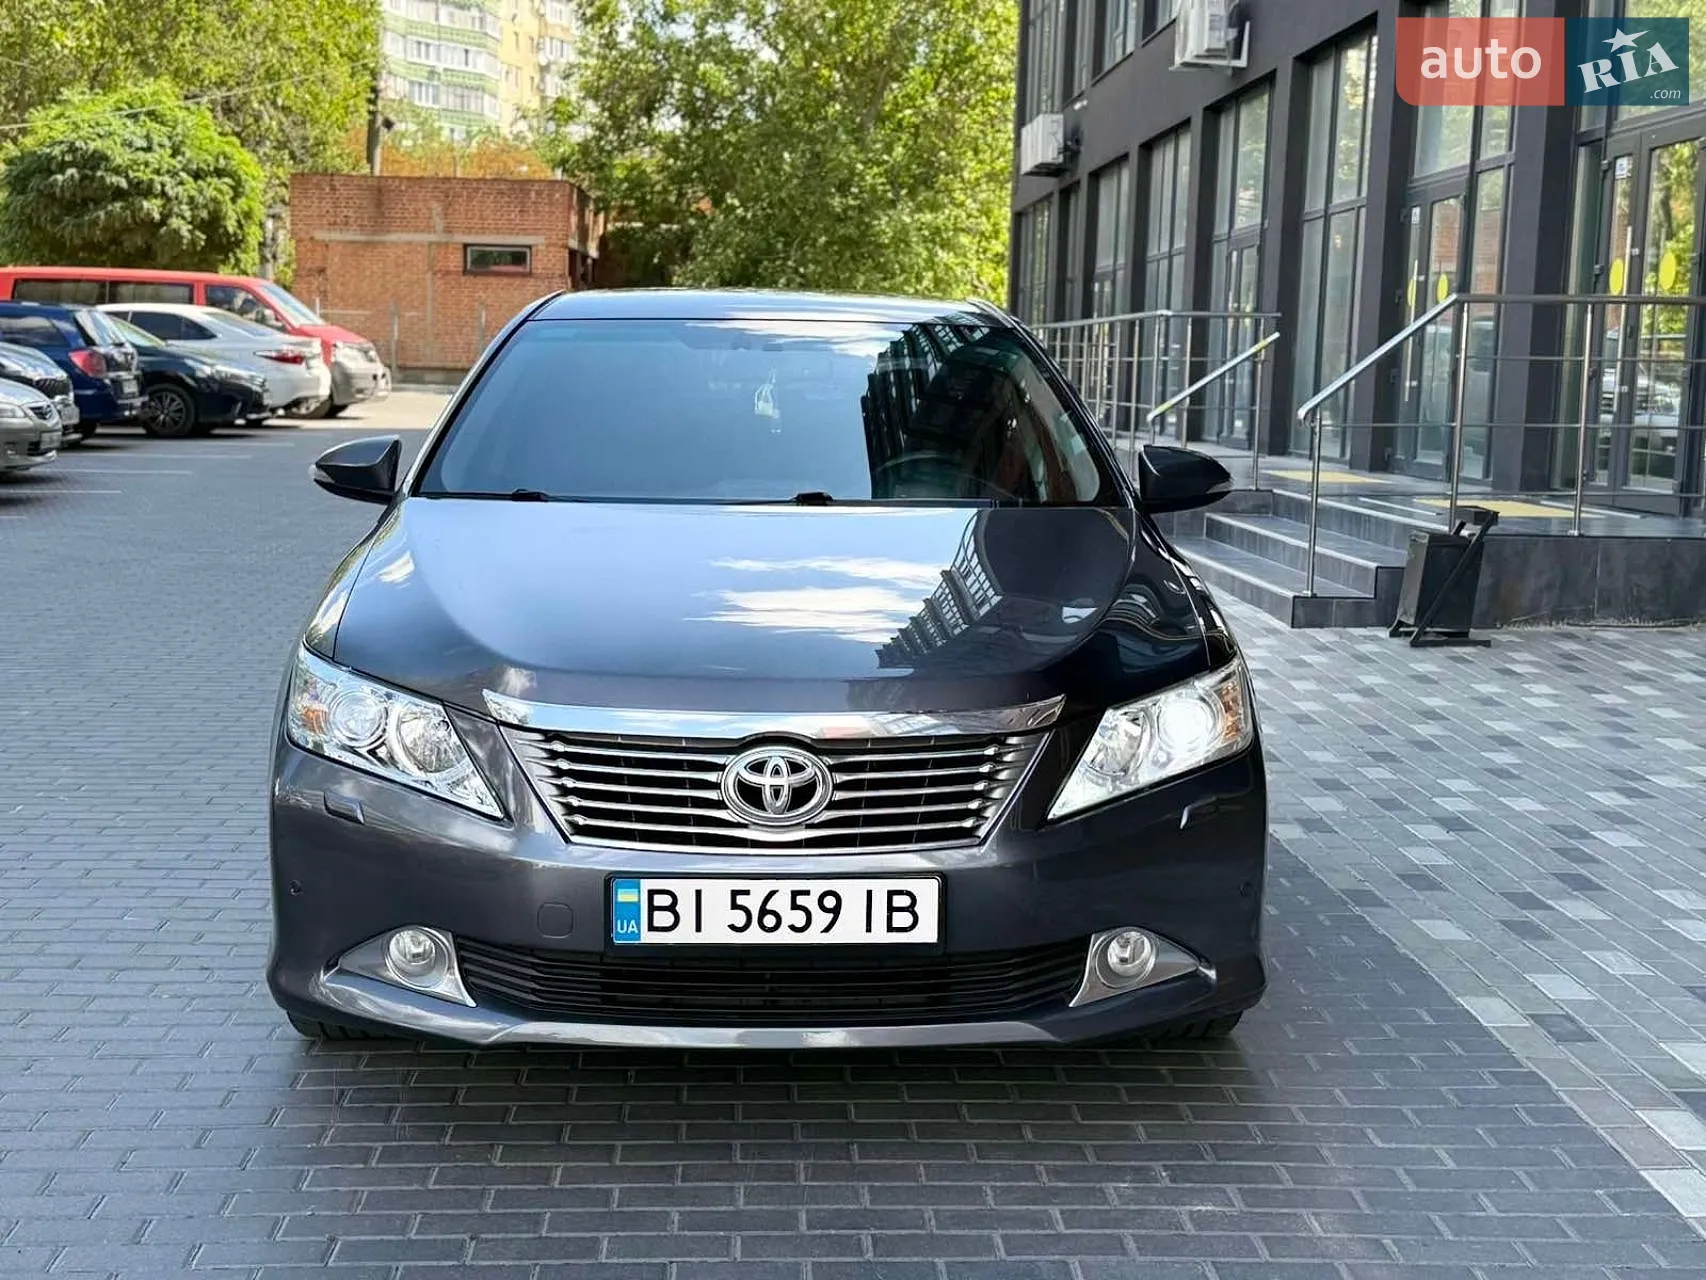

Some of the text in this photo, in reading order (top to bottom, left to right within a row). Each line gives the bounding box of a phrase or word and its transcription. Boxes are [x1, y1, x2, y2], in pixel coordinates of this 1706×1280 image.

[647, 888, 919, 934] BI 5659 IB
[616, 919, 639, 934] UA
